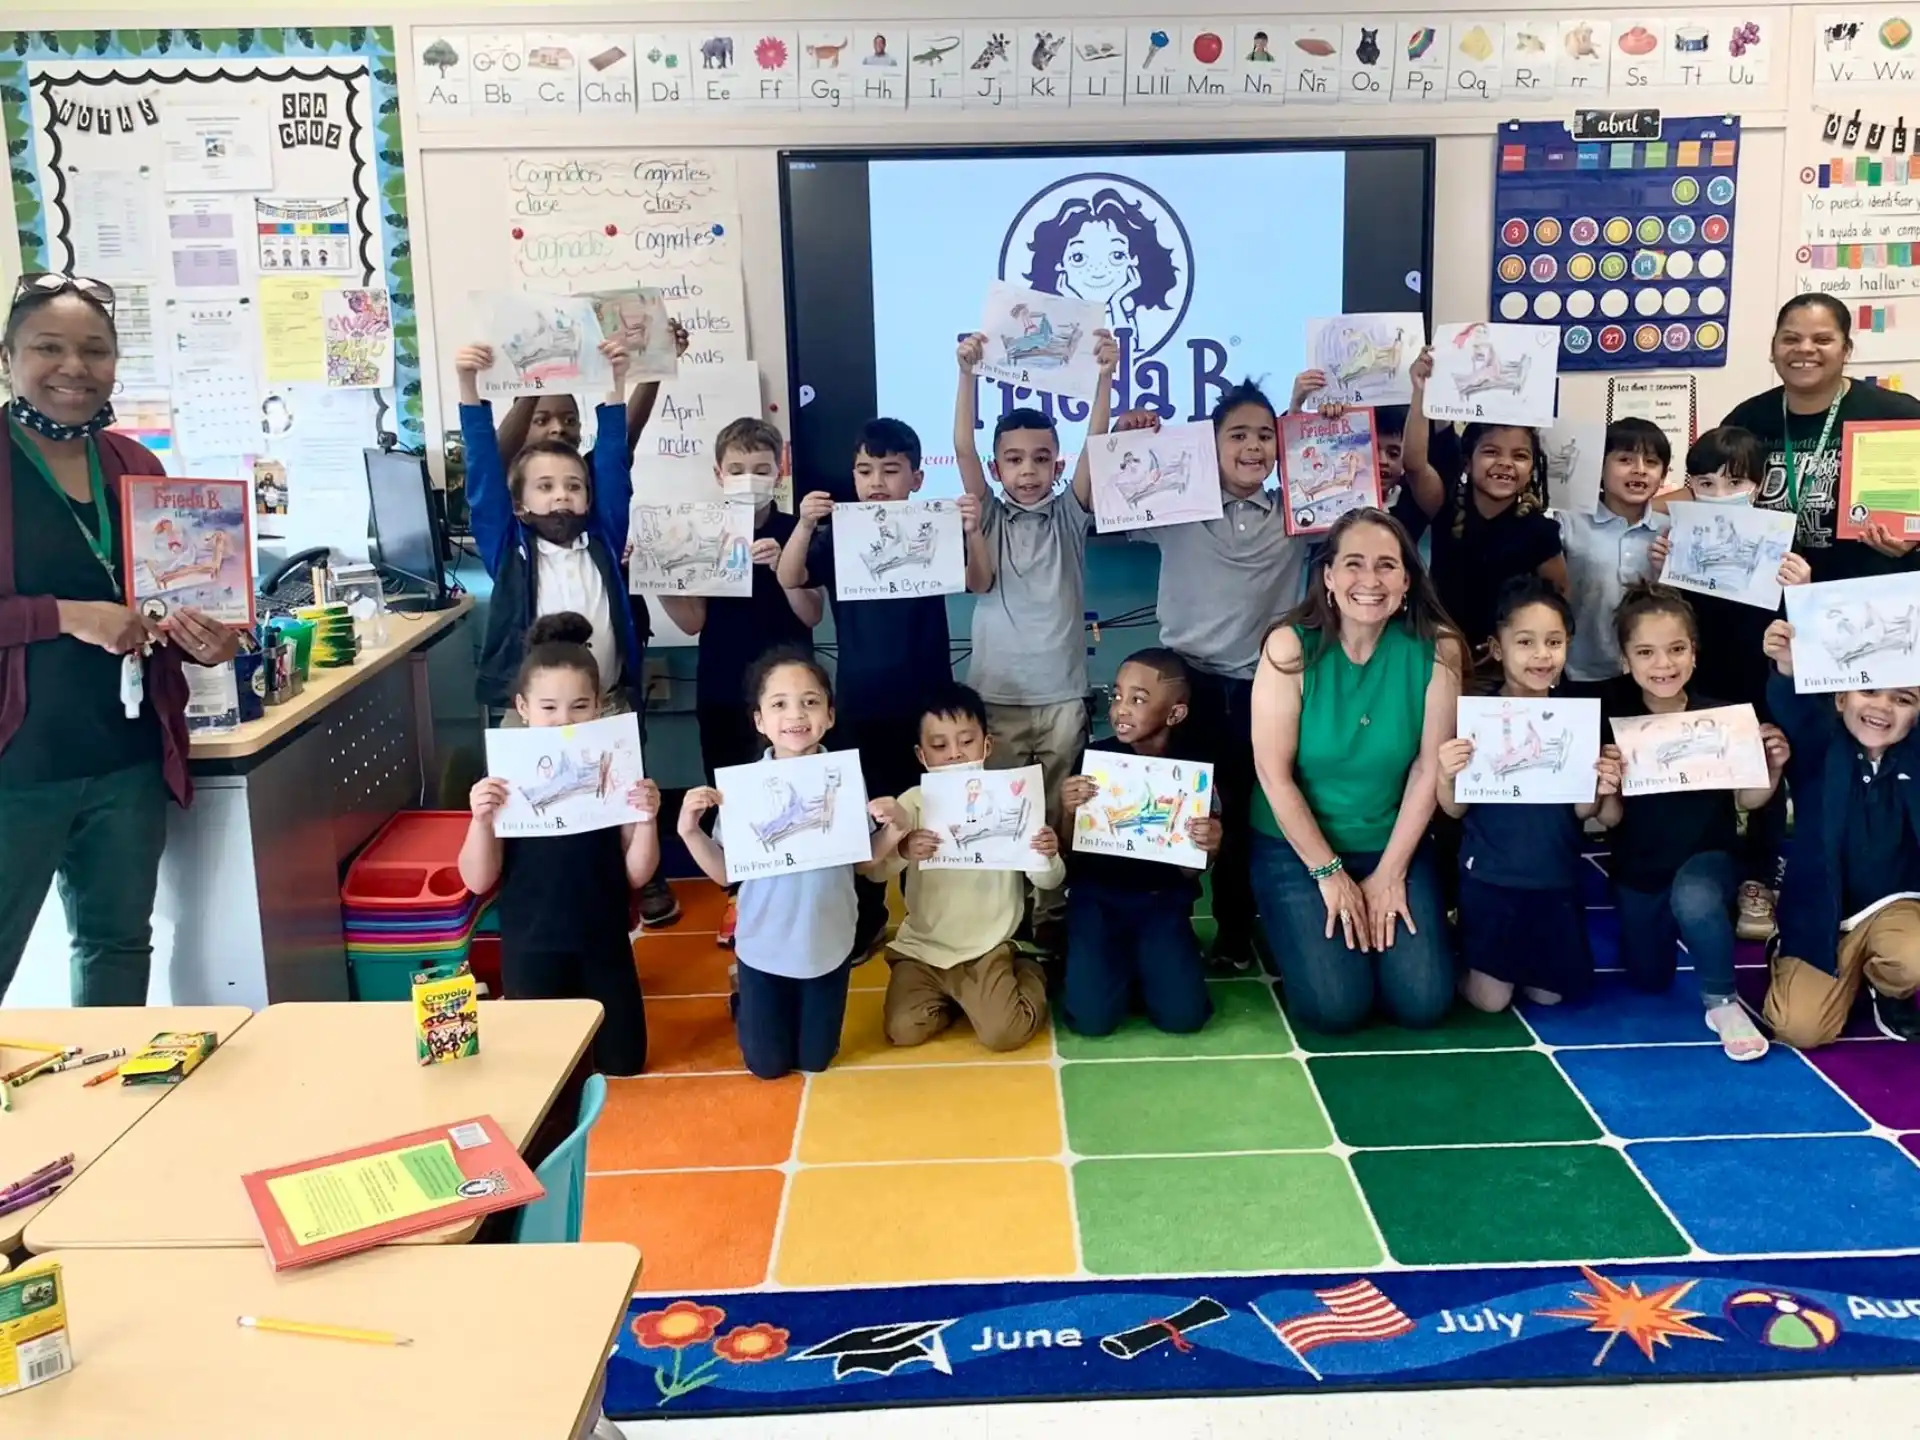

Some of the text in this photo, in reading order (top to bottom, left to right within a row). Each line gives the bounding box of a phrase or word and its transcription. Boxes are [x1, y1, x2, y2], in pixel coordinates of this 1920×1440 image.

[1830, 61, 1915, 82] Vv Ww
[429, 85, 458, 105] Aa
[484, 84, 511, 104] Bb
[538, 82, 565, 103] Cc
[652, 82, 680, 102] Dd
[707, 81, 730, 101] Ee
[760, 79, 783, 99] Ff
[811, 79, 840, 107] Gg
[866, 78, 892, 99] Hh
[978, 77, 1001, 105] Jj
[1031, 77, 1055, 97] Kk
[1187, 75, 1224, 95] Mm
[1245, 74, 1272, 94] Nn
[1299, 69, 1326, 93] Ññ
[1352, 71, 1379, 92] Oo
[1407, 71, 1433, 98] Pp
[1458, 70, 1489, 98] Qq
[1515, 68, 1540, 88] Rr
[1571, 74, 1588, 88] rr
[1626, 67, 1648, 87] Ss
[1681, 66, 1702, 86] Tt
[1729, 66, 1754, 85] Uu
[59, 98, 156, 131] NOTAS
[284, 95, 326, 115] SRA
[1597, 113, 1639, 134] abril
[282, 123, 340, 146] CRUZ
[1716, 185, 1726, 197] 2
[643, 194, 692, 211] class
[1808, 193, 1824, 211] Yo
[1830, 190, 1863, 215] puedo
[1511, 227, 1520, 238] 3
[1543, 226, 1551, 237] 4
[1580, 226, 1588, 238] 5
[1712, 225, 1719, 235] 9
[1800, 272, 1906, 293] Yo puedo hallar
[1571, 335, 1585, 346] 26
[1605, 334, 1620, 345] 27
[661, 394, 705, 431] April
[1300, 419, 1340, 439] Frieda
[658, 433, 704, 455] order
[153, 487, 205, 509] Frieda
[425, 988, 468, 1002] Crayola
[971, 1326, 1083, 1351] June
[1437, 1309, 1524, 1337] July
